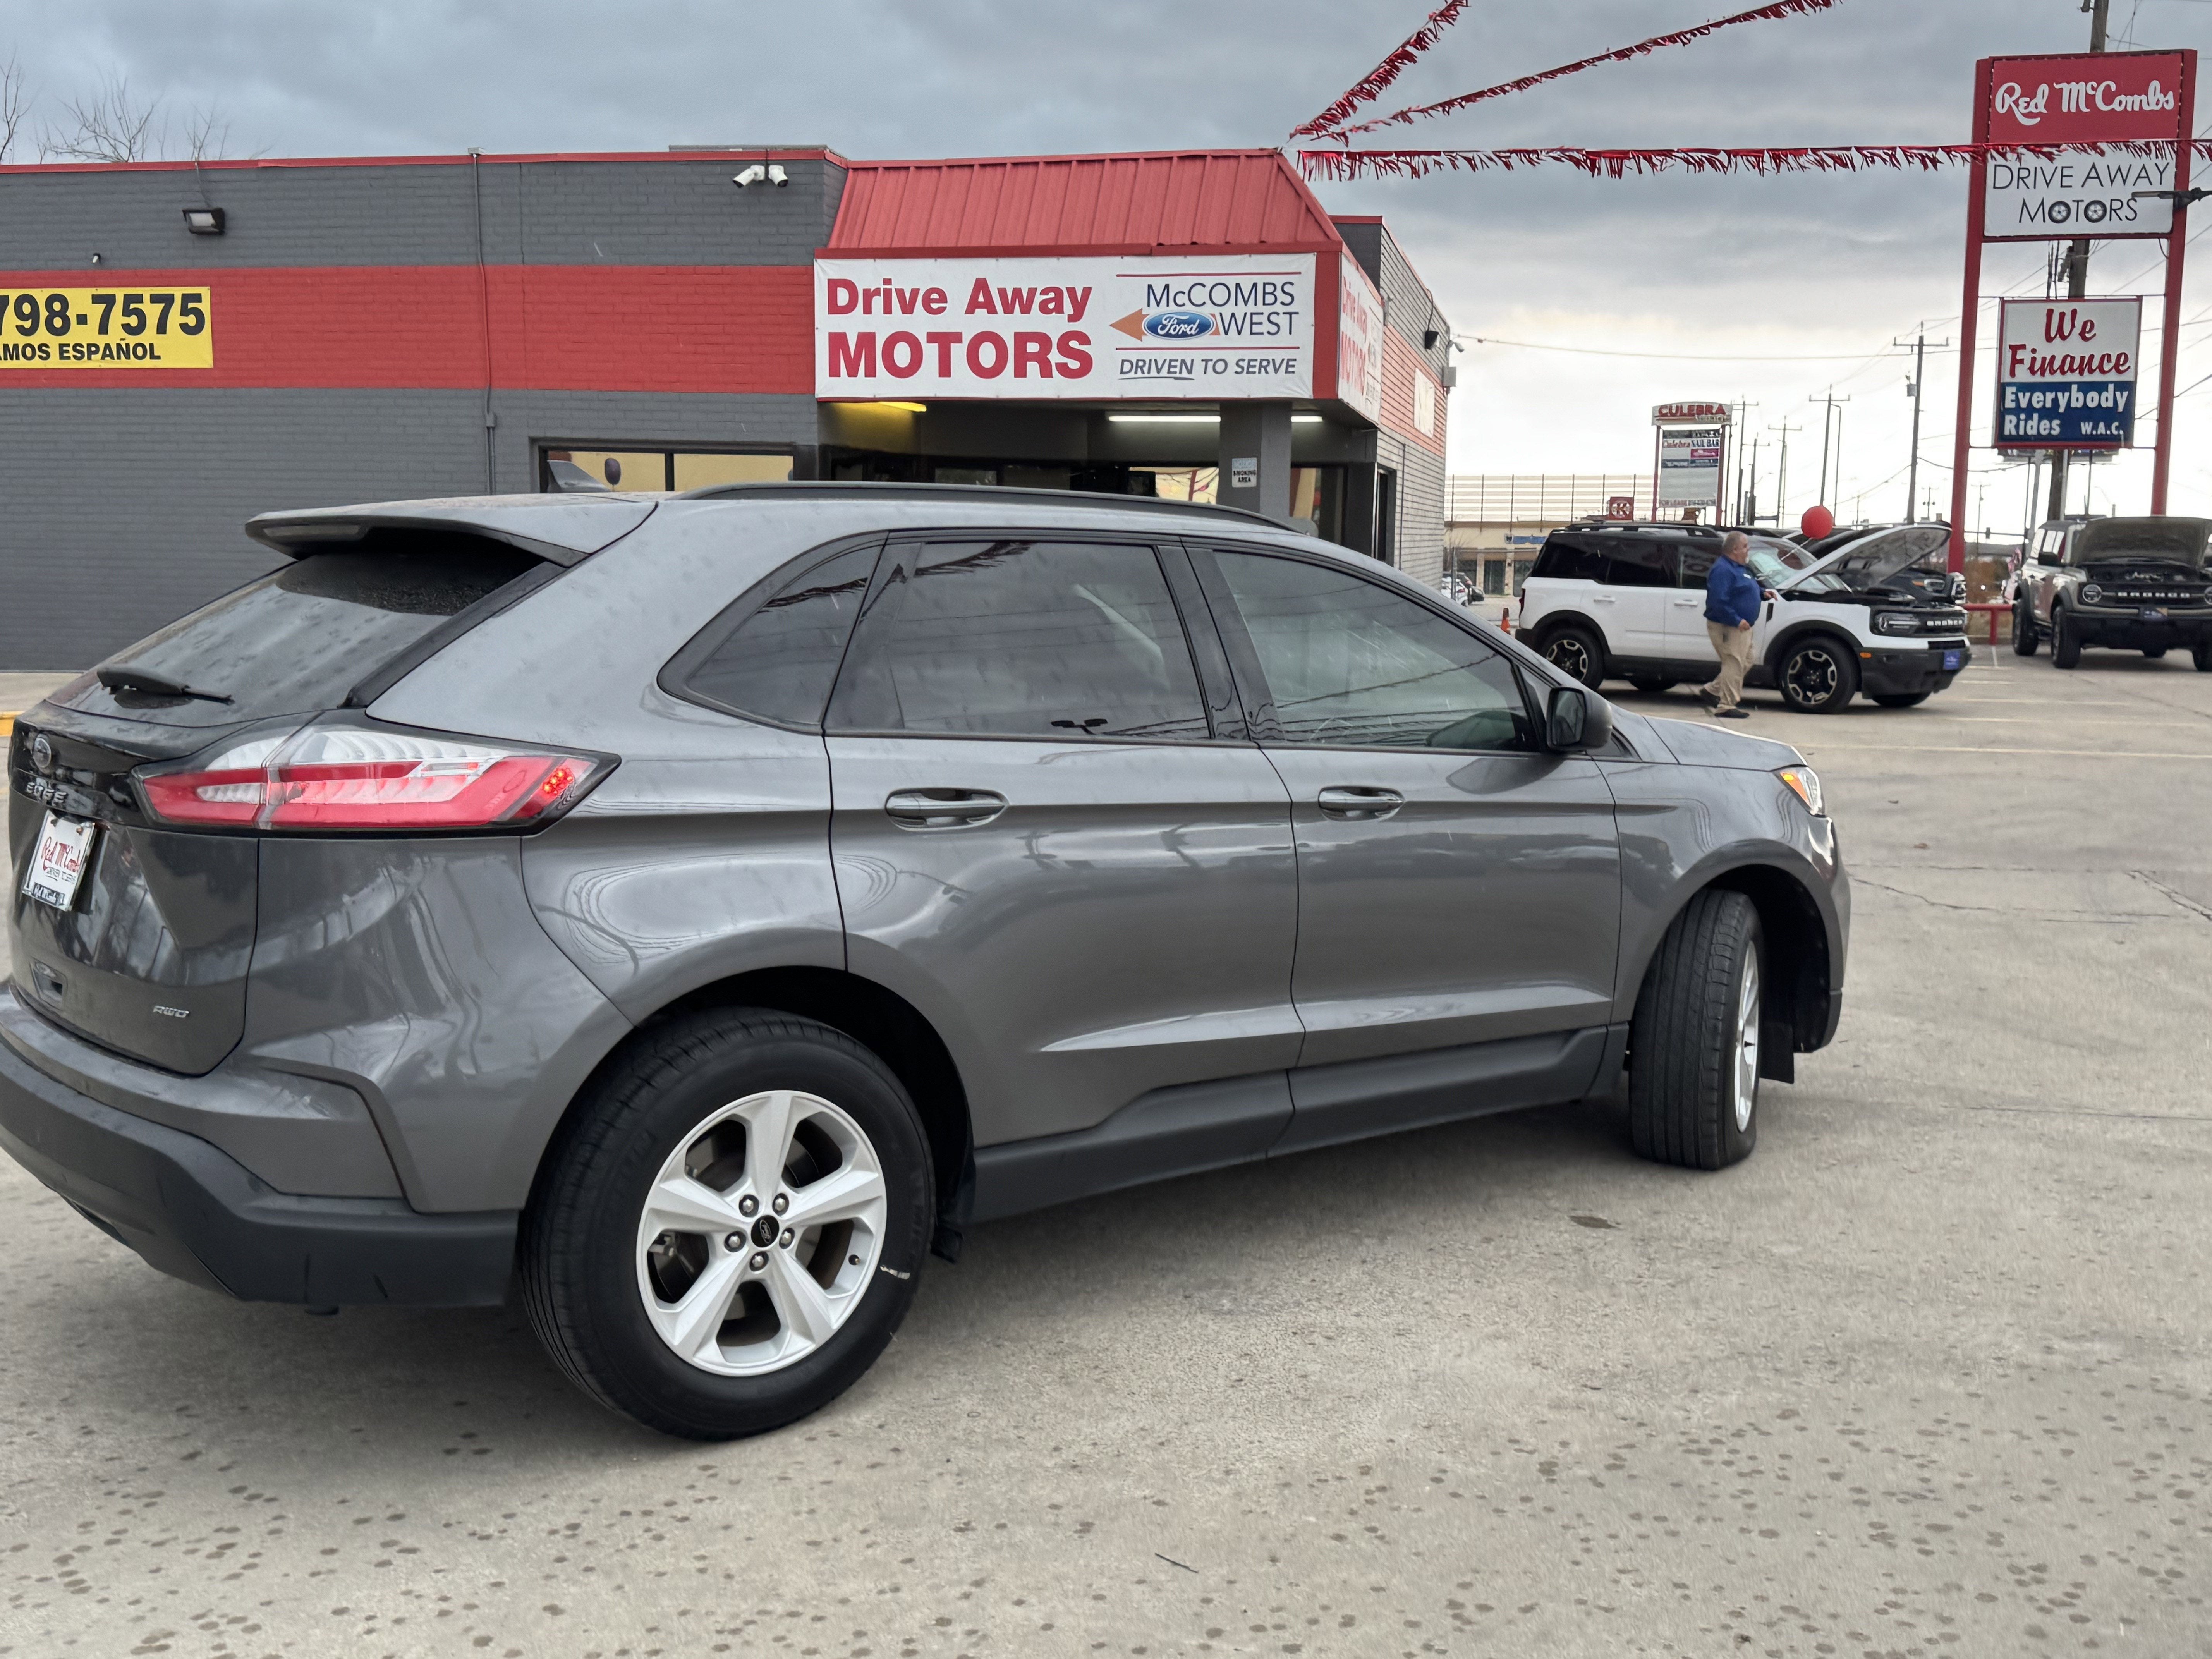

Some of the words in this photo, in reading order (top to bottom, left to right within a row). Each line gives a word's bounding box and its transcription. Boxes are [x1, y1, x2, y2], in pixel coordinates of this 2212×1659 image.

[1995, 82, 2049, 125] Red
[2054, 80, 2174, 113] McCombs
[1993, 164, 2074, 189] DRIVE
[2081, 162, 2170, 188] AWAY
[2019, 197, 2138, 223] MOTORS
[828, 278, 948, 315] Drive
[965, 278, 1092, 323] Away
[1147, 282, 1295, 307] McCOMBS
[1158, 314, 1200, 335] Ford
[1219, 312, 1299, 336] WEST
[2045, 308, 2097, 343] We
[0, 343, 51, 361] MOS
[58, 338, 161, 361] ESPAÑOL
[828, 330, 1093, 379] MOTORS
[2009, 344, 2131, 378] Finance
[1120, 359, 1194, 375] DRIVEN
[1201, 359, 1228, 374] TO
[1235, 358, 1297, 374] SERVE
[1659, 404, 1726, 416] CULEBRA
[2004, 383, 2128, 412] Everybody
[2004, 413, 2061, 435] Rides
[2081, 421, 2123, 434] W.A.C.
